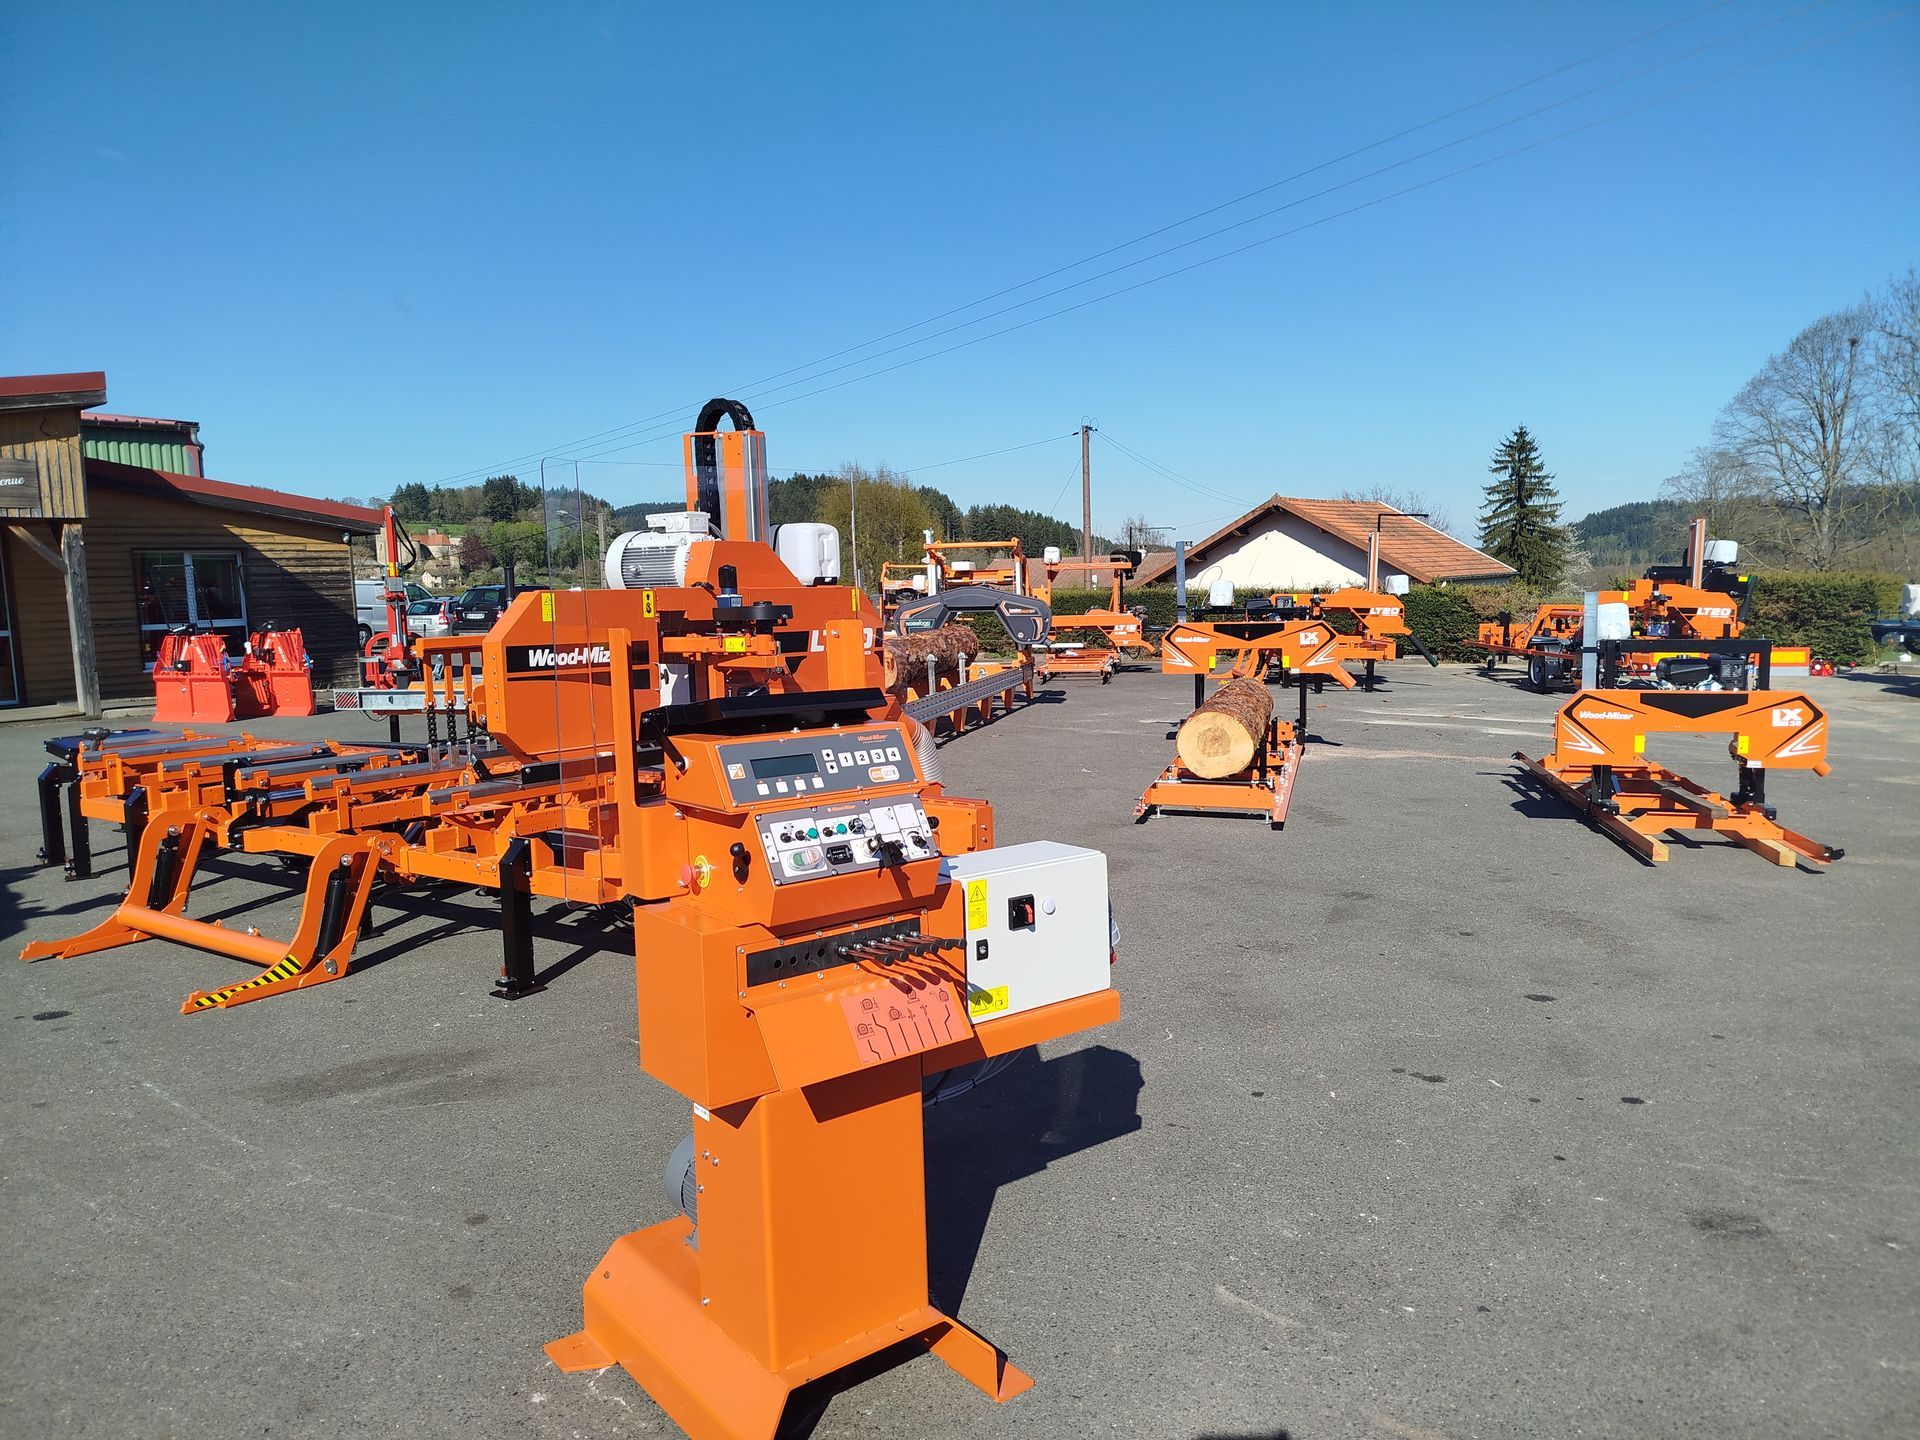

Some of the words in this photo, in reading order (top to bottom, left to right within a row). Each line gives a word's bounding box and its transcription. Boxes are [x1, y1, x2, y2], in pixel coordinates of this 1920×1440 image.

[0, 477, 26, 486] enue
[528, 646, 611, 667] Wood-Miz
[1579, 710, 1634, 720] Wood-Mizer
[857, 734, 888, 742] Wood-Mizer
[875, 752, 881, 760] 3
